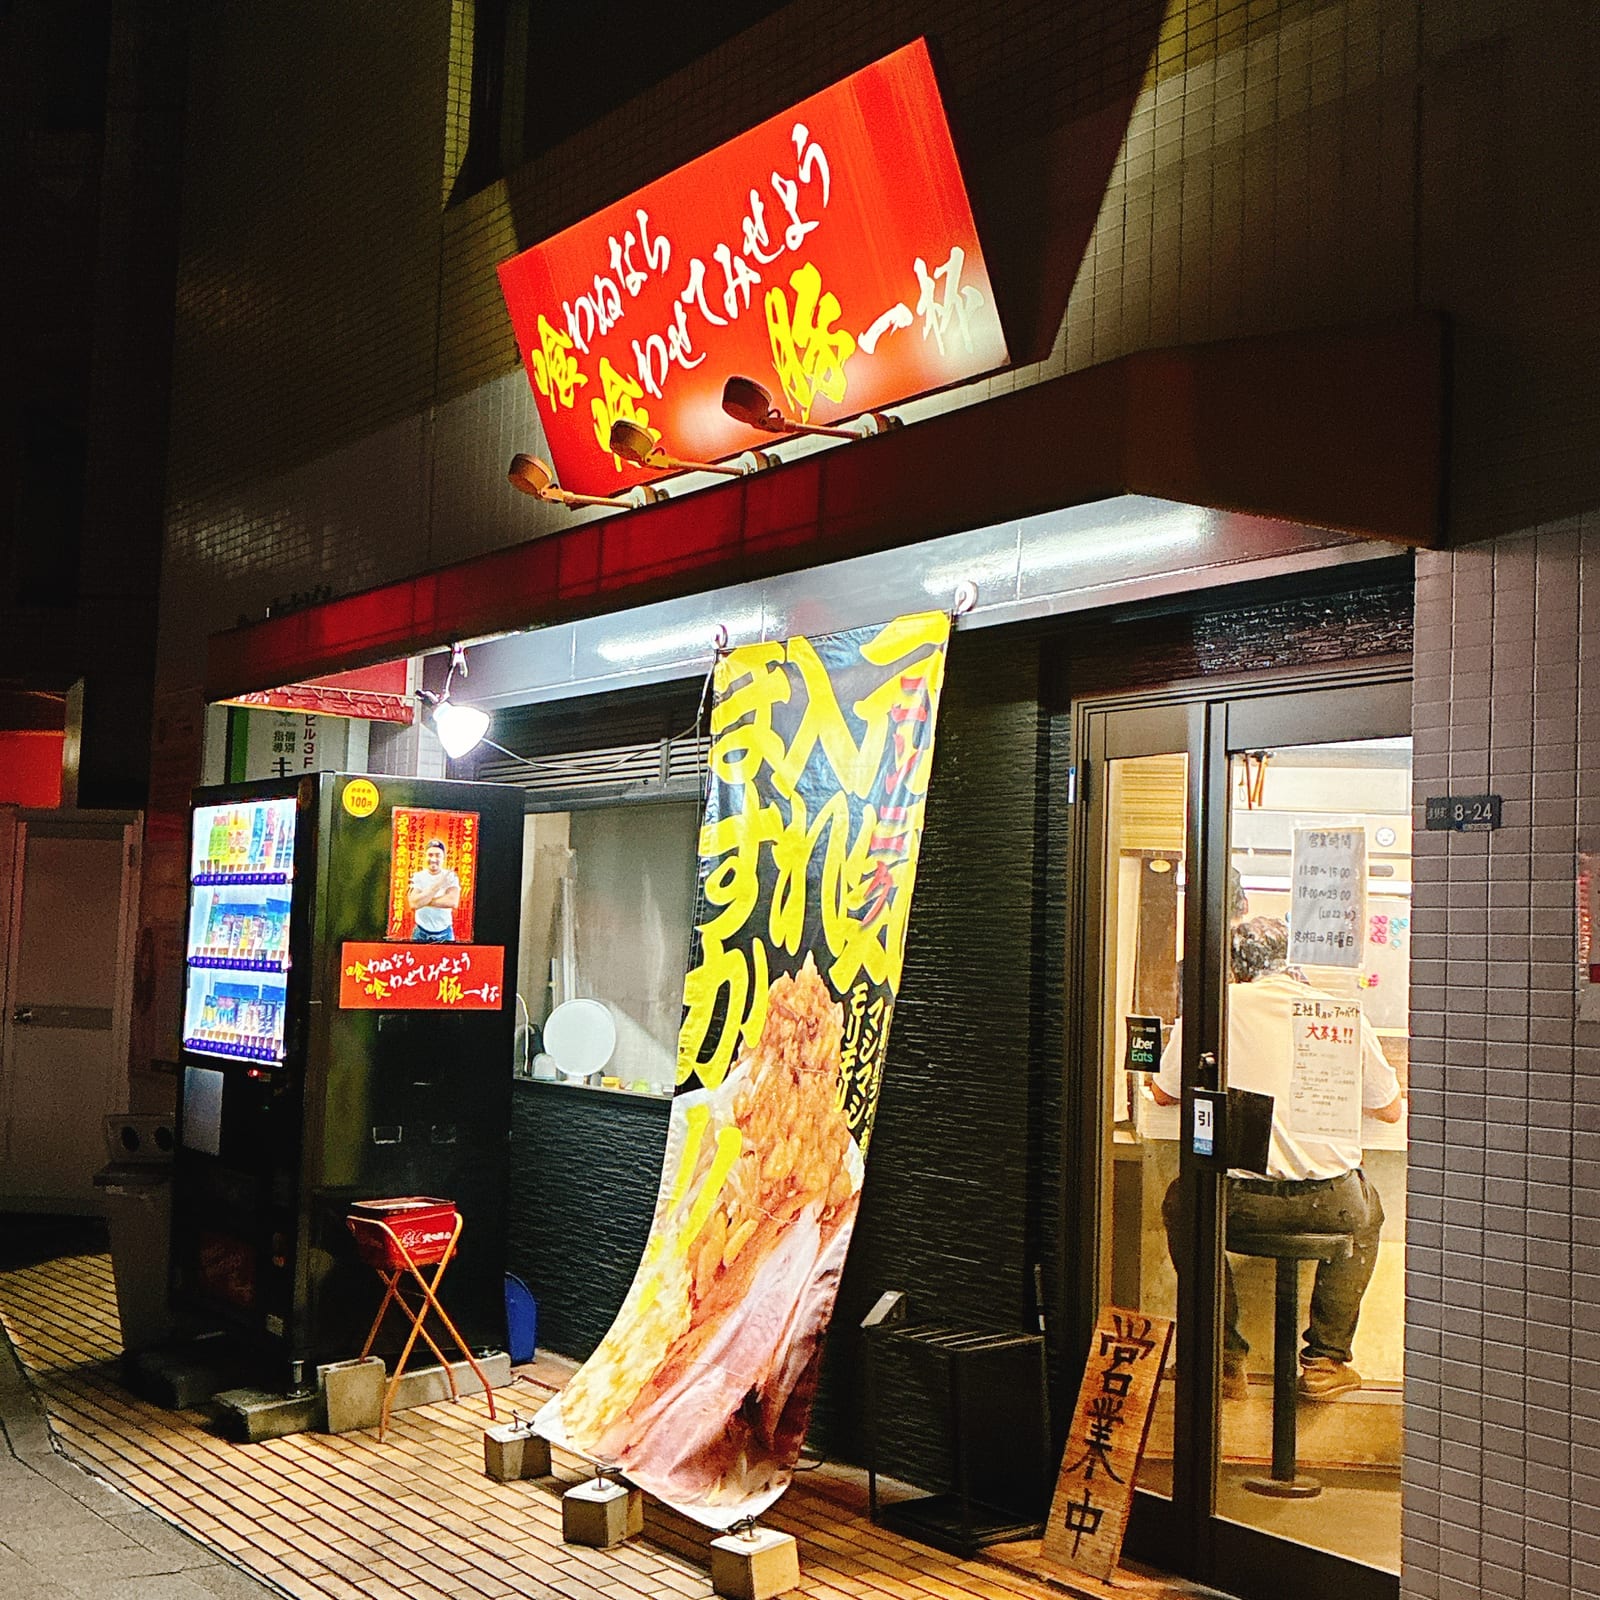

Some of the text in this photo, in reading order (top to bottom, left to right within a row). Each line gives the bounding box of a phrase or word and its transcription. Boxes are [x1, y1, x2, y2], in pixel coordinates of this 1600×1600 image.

[532, 209, 671, 411] 喰わぬなら
[764, 246, 984, 424] 豚一杯
[860, 675, 929, 928] ニンニク
[1454, 803, 1493, 821] 8-24
[345, 951, 415, 983] 喰わぬなら
[364, 952, 471, 1000] 喰わせてみせよう
[436, 975, 500, 1004] 豚一杯
[834, 981, 868, 1113] モリモリ
[846, 997, 884, 1130] マシマシ
[1131, 1050, 1154, 1063] Eats
[1132, 1036, 1155, 1050] Uber
[1197, 1110, 1211, 1128] 引
[1065, 1314, 1156, 1560] 営業中
